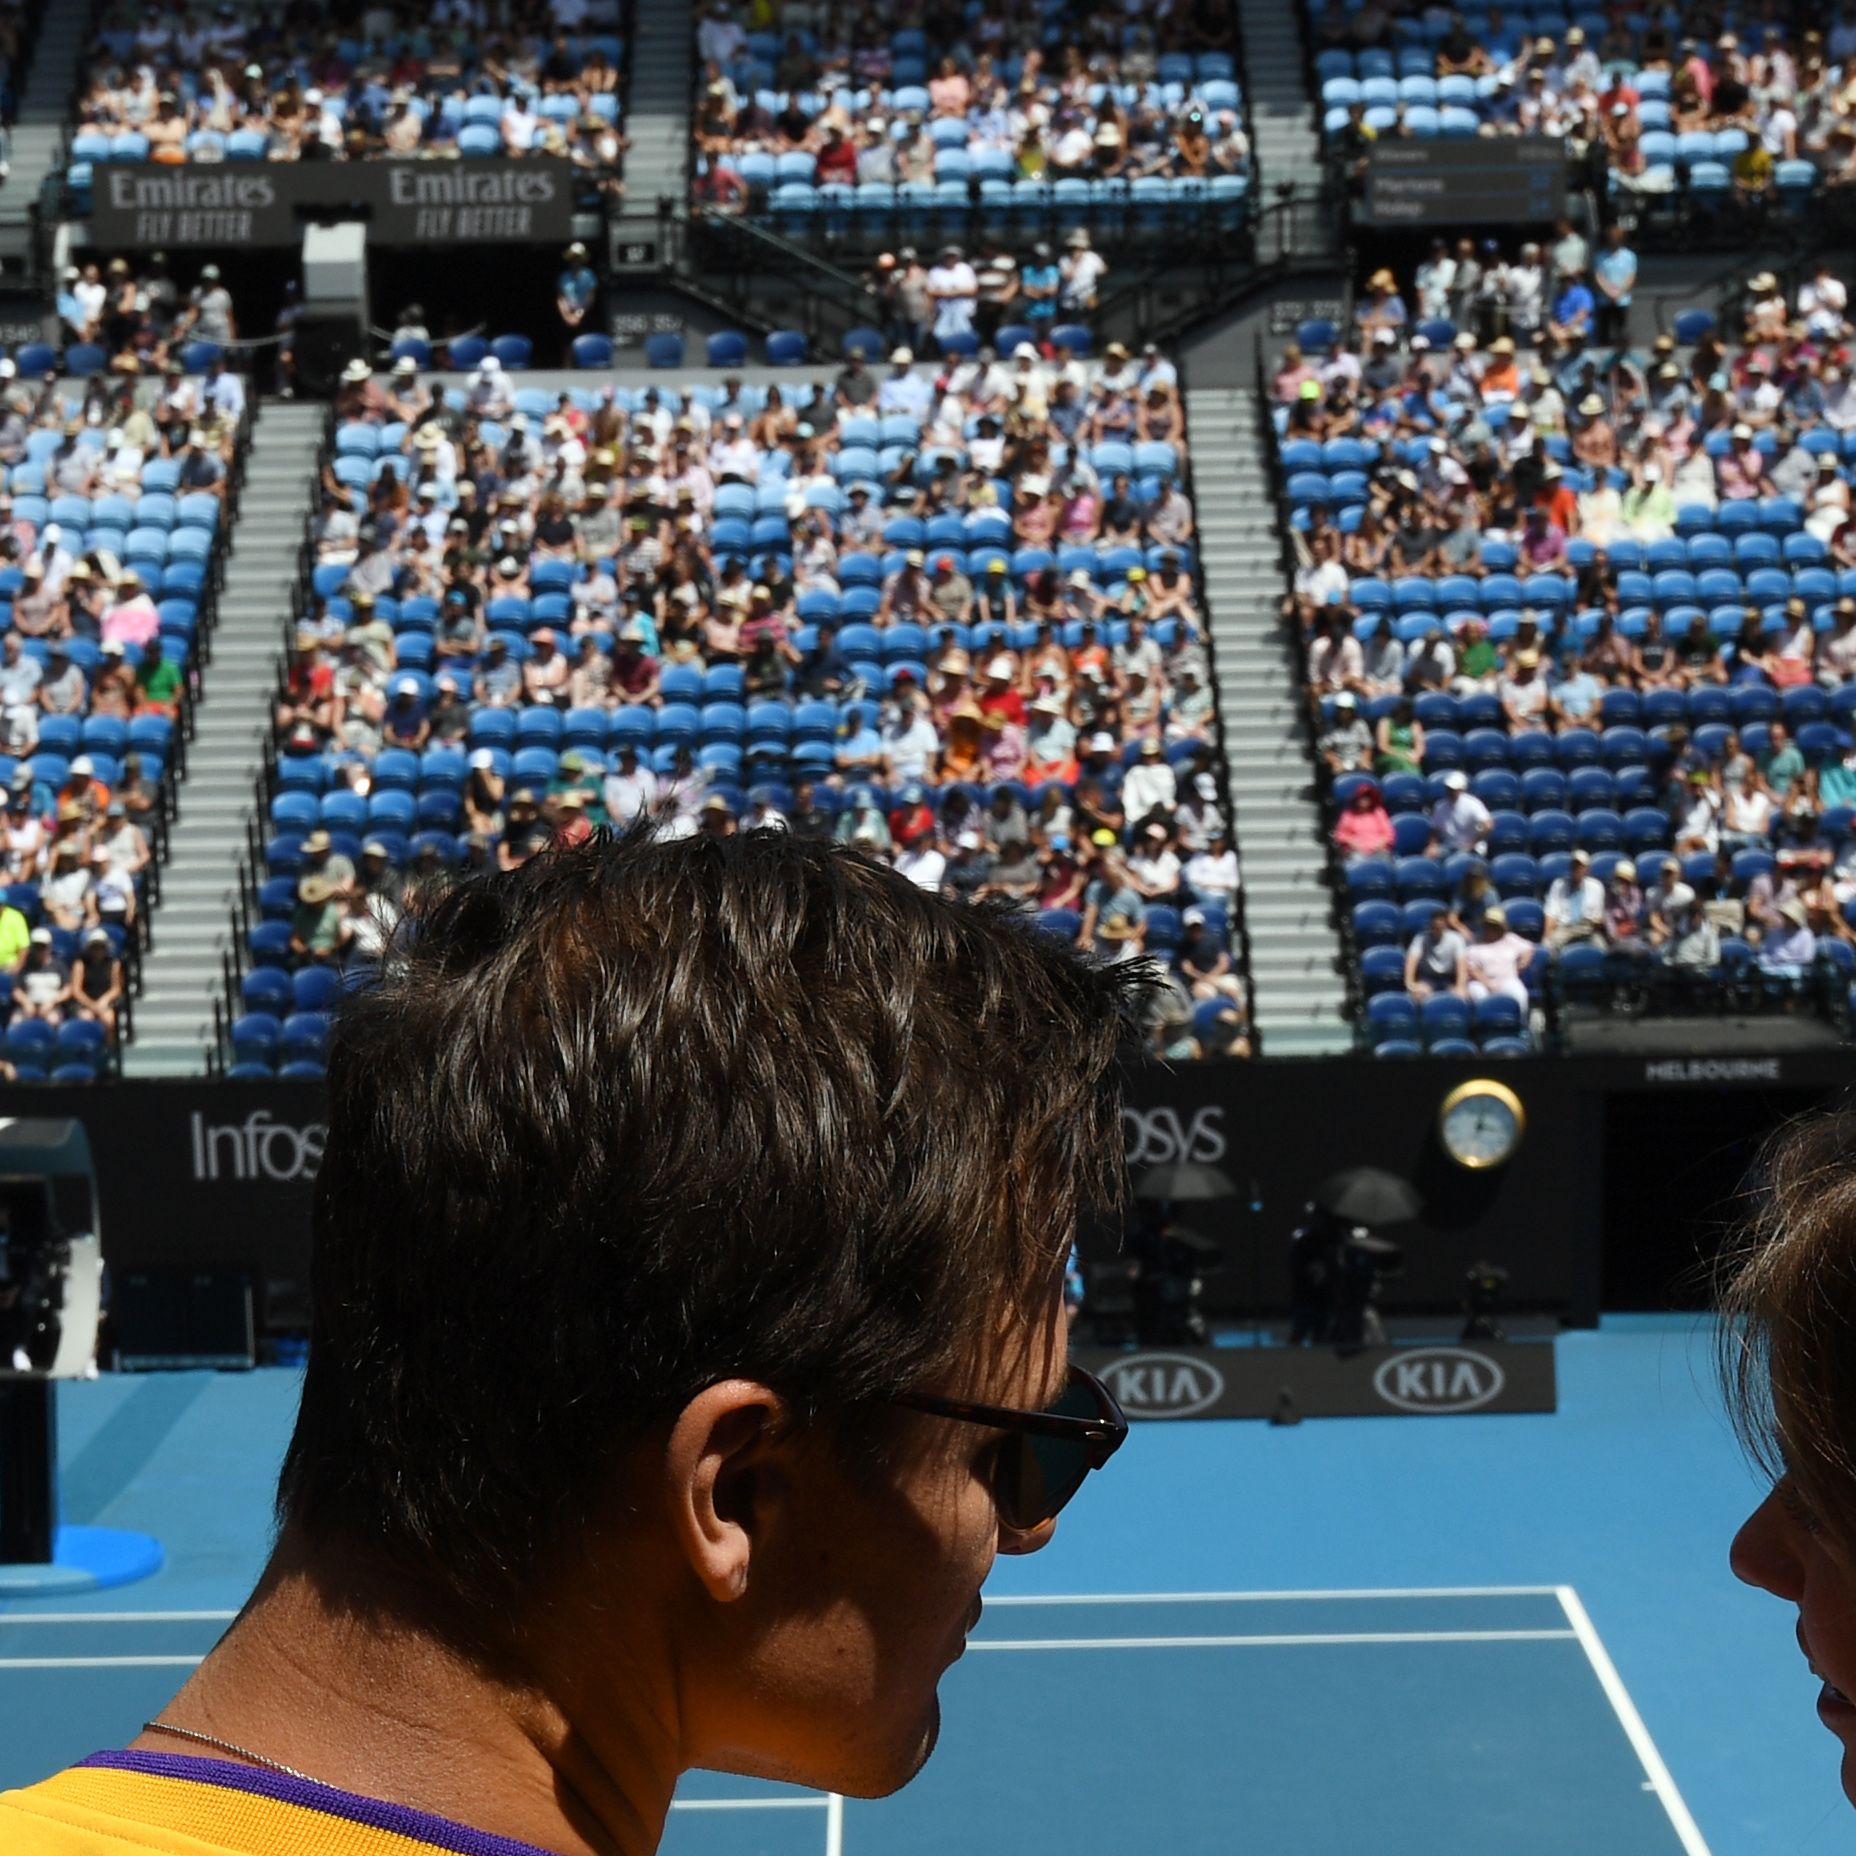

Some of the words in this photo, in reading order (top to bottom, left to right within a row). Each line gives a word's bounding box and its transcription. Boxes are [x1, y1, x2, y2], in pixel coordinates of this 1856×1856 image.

[108, 169, 276, 209] Emirates
[389, 165, 557, 206] Emirates
[191, 1109, 330, 1182] Infos
[1116, 1365, 1202, 1402] KIA
[1397, 1360, 1482, 1398] KIA
